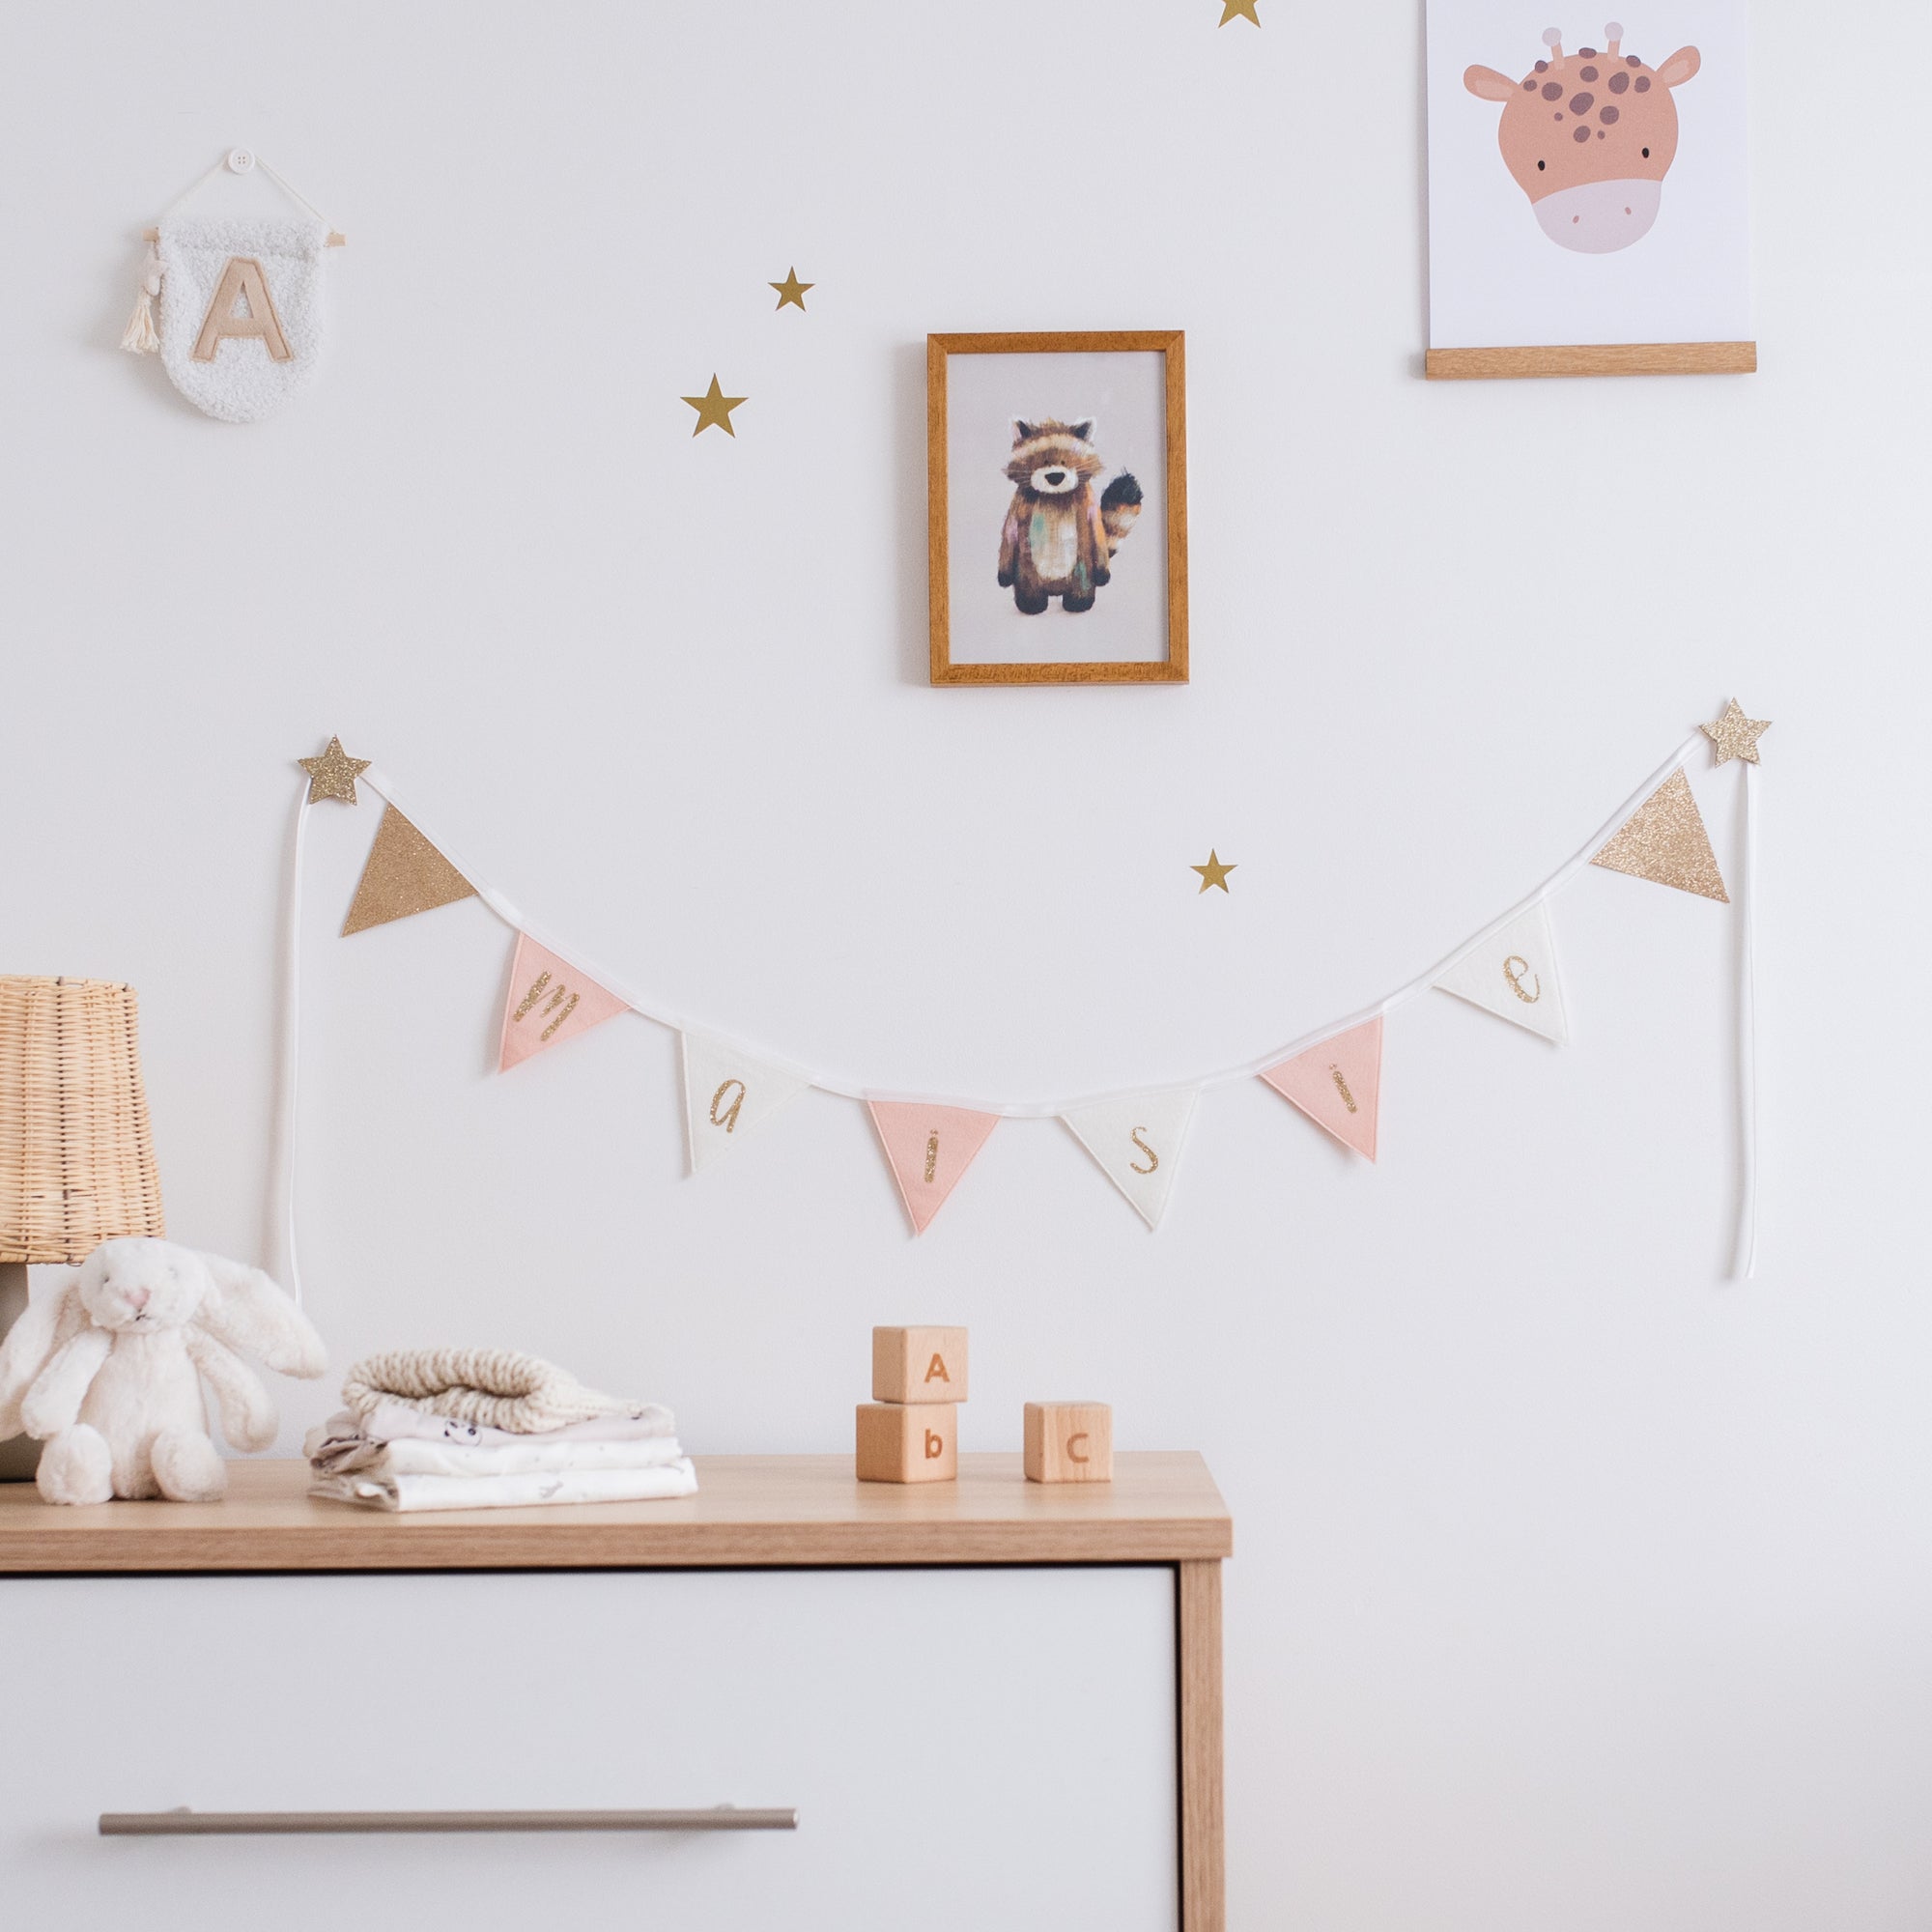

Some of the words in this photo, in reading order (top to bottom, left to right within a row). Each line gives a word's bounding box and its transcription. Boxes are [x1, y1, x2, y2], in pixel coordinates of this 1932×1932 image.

[191, 256, 294, 363] A
[924, 1353, 951, 1383] A
[924, 1429, 943, 1459] b
